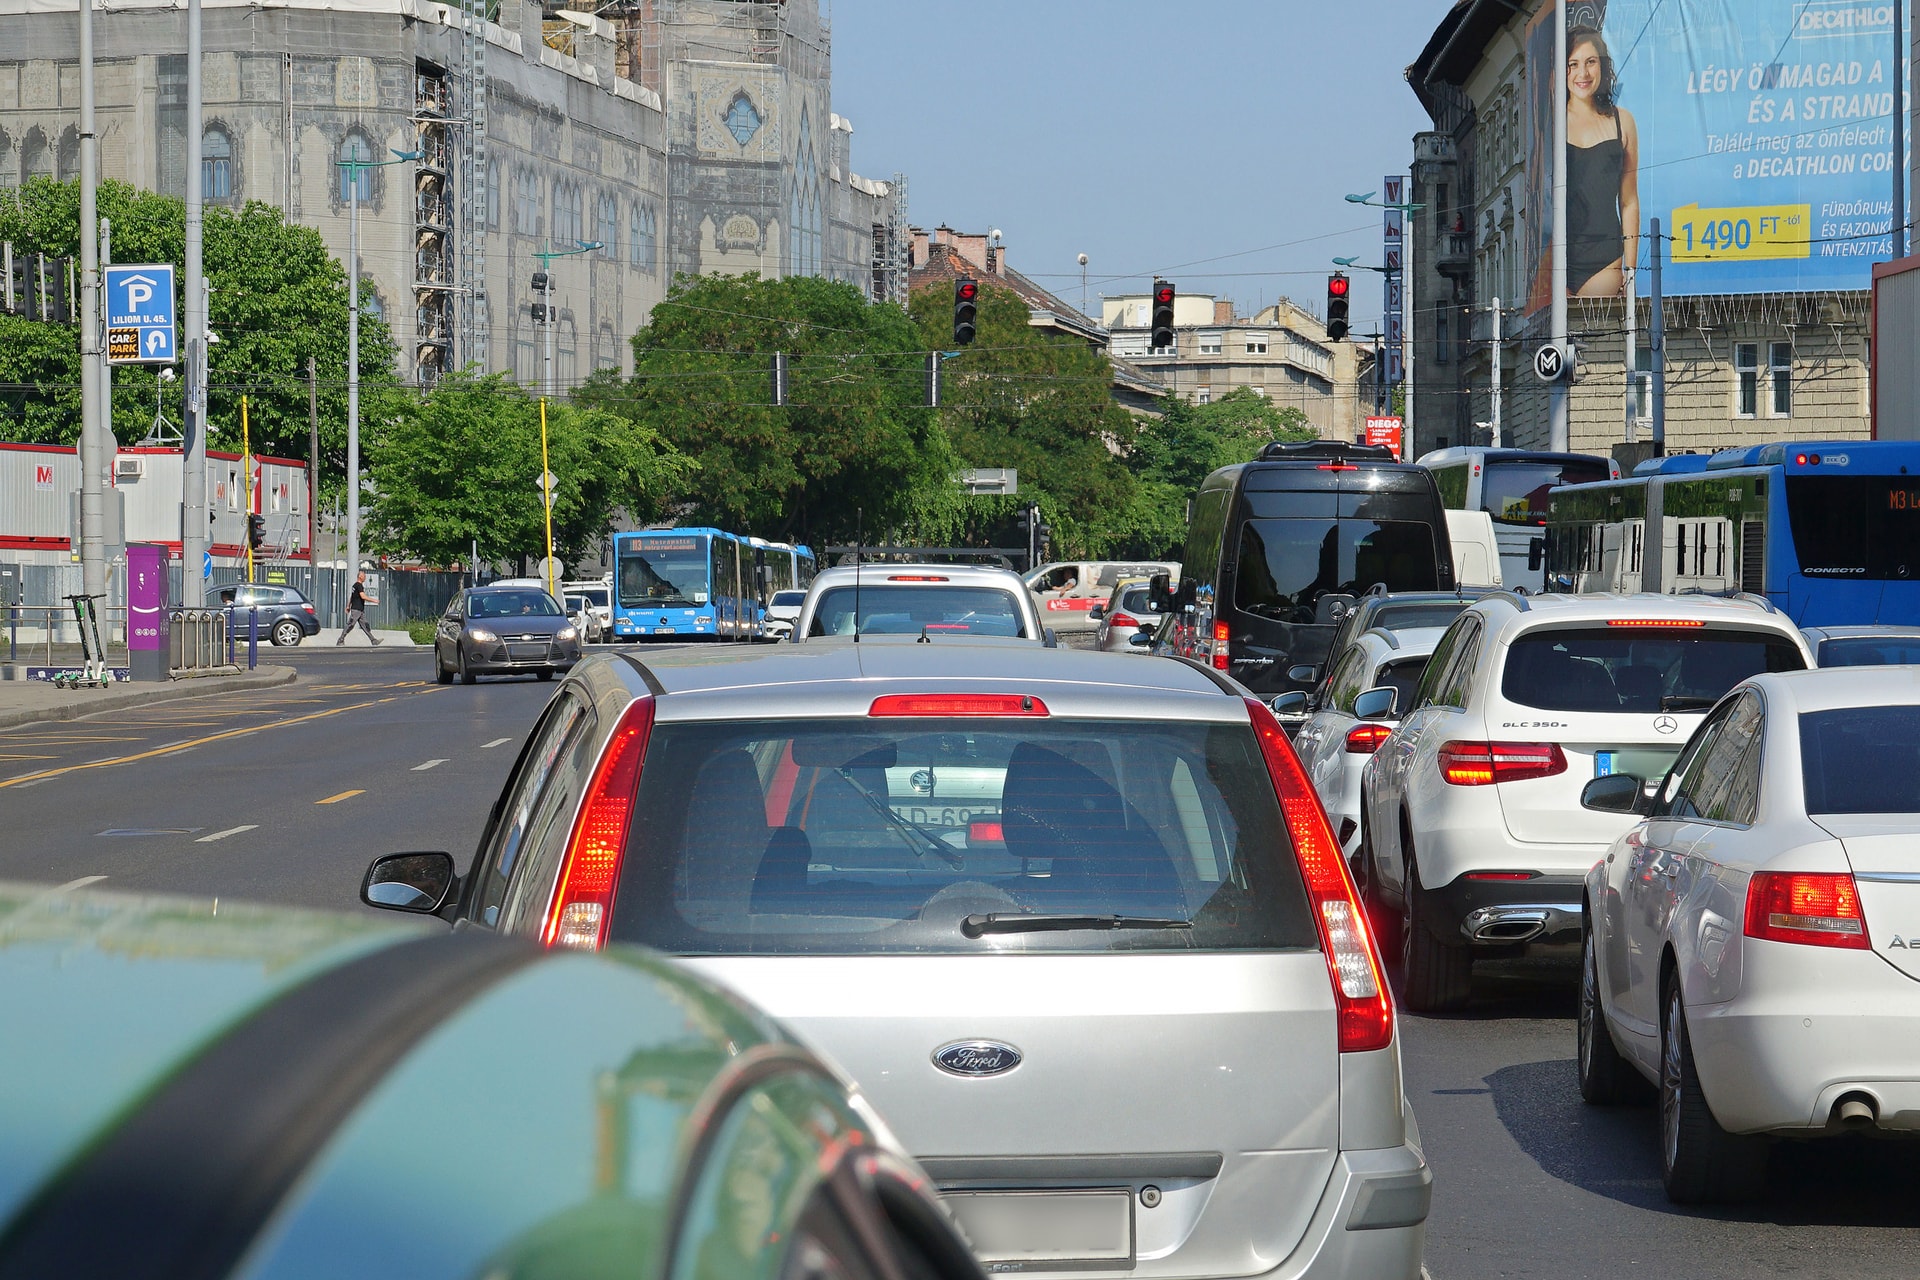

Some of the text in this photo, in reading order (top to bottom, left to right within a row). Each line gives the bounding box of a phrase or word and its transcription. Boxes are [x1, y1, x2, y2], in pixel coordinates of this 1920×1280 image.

[1687, 65, 1743, 94] LÉGY
[1748, 62, 1862, 91] ÖNMAGAD
[1867, 60, 1883, 83] A
[1747, 95, 1775, 124] ÉS
[1779, 98, 1796, 122] A
[1706, 132, 1752, 154] Találd
[1755, 136, 1791, 155] meg
[1795, 134, 1814, 149] az
[1818, 125, 1886, 148] önfeledt
[1733, 163, 1743, 179] a
[1747, 155, 1856, 179] DECATHLON
[1759, 216, 1781, 235] FT
[1821, 220, 1837, 237] ÉS
[1821, 238, 1893, 257] INTENZITÁS
[112, 314, 167, 324] LILIOM U. 45.
[110, 344, 137, 353] PARK
[1367, 419, 1400, 428] DIEGO
[1890, 490, 1906, 509] M3
[952, 1047, 1002, 1068] Ford
